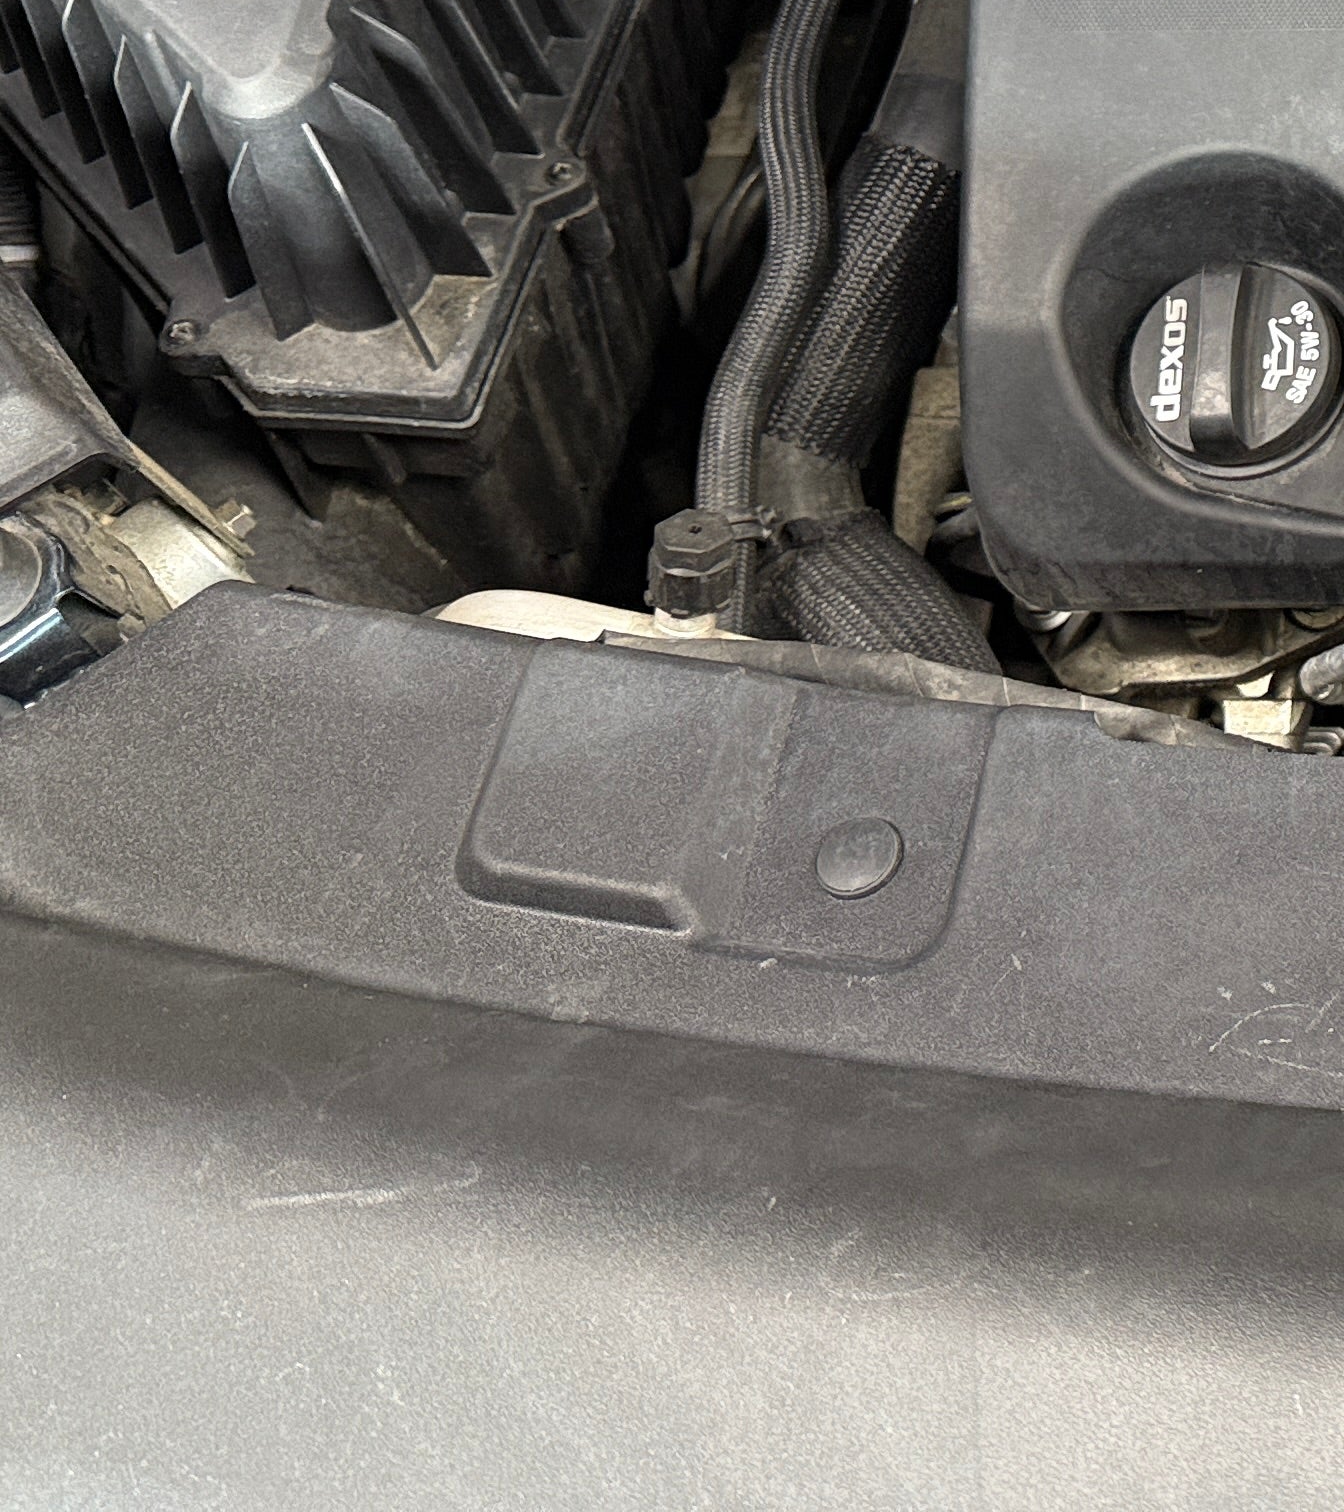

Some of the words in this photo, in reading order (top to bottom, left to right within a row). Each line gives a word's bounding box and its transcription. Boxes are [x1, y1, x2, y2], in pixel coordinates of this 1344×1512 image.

[1150, 295, 1188, 422] dexos
[1290, 300, 1320, 361] 5W-30
[1285, 365, 1316, 404] SAE
